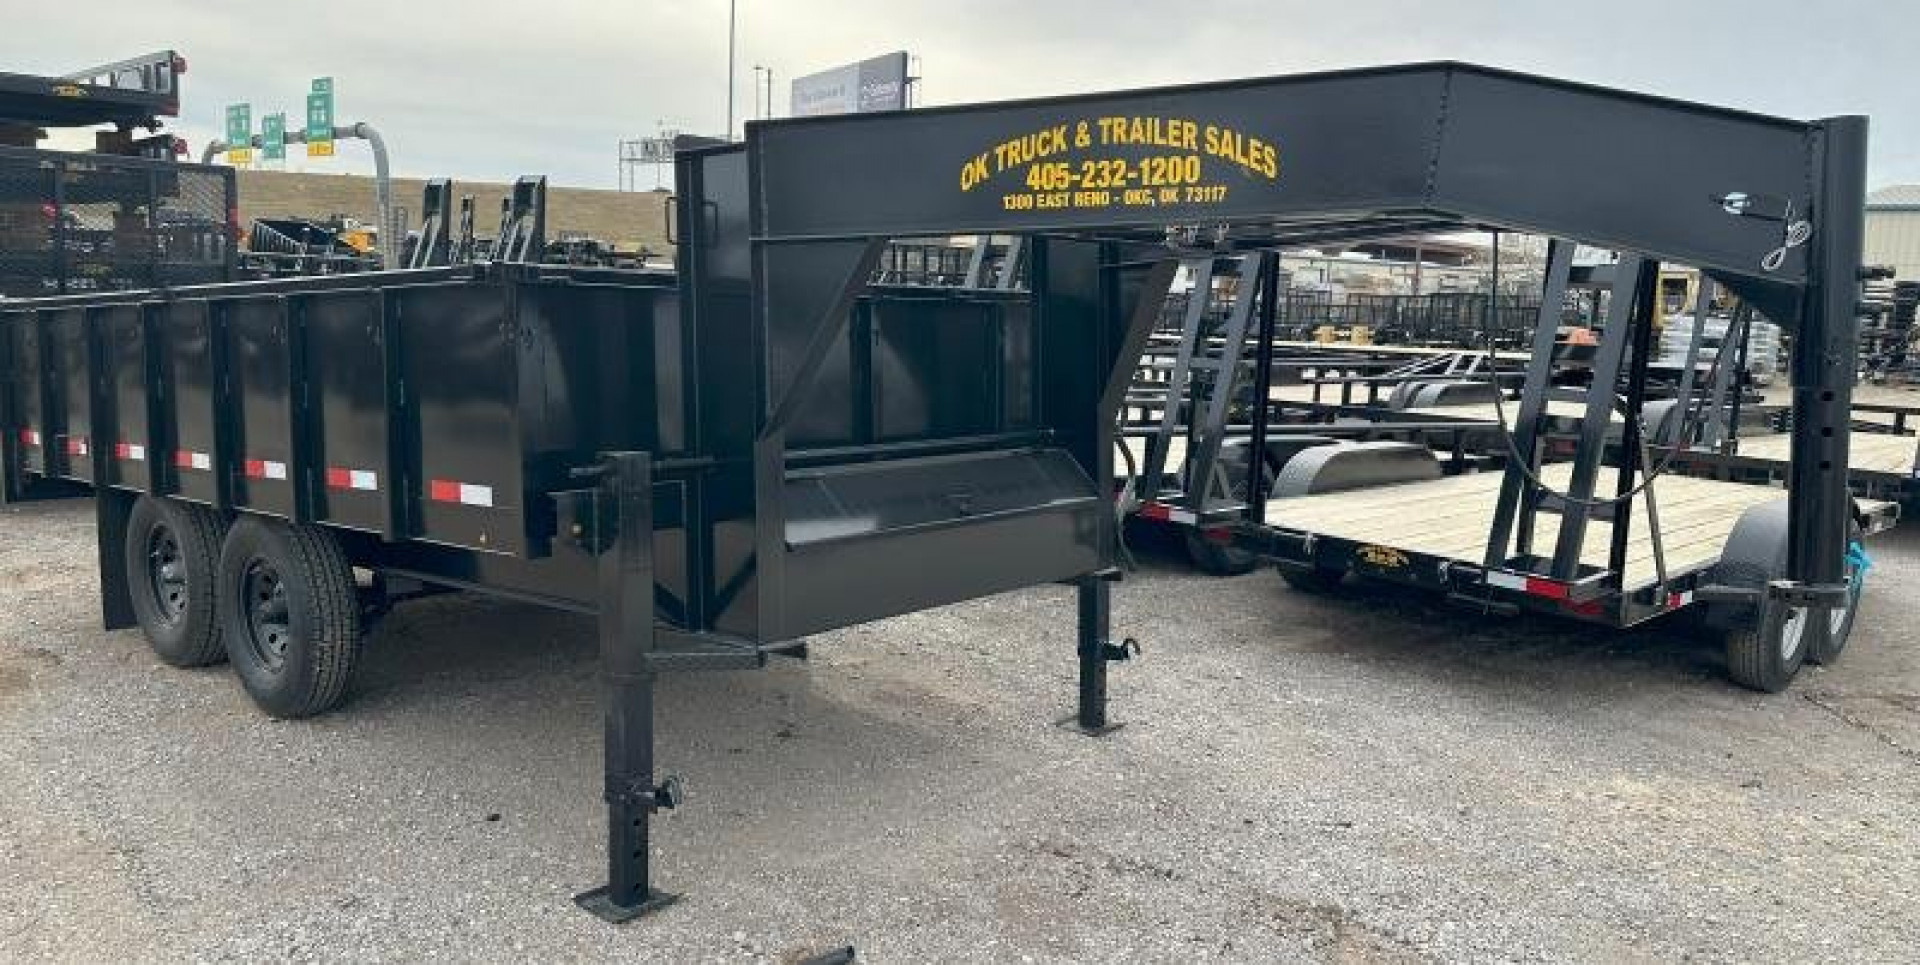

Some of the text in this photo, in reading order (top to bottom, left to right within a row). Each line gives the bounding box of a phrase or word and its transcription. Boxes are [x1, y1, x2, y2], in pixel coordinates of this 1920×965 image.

[960, 116, 1277, 190] OK TRUCK & TRAILER SALES
[1026, 155, 1200, 190] 405-232-1200
[1036, 191, 1069, 207] EAST
[1074, 191, 1110, 207] RENO
[1185, 185, 1228, 202] 73117
